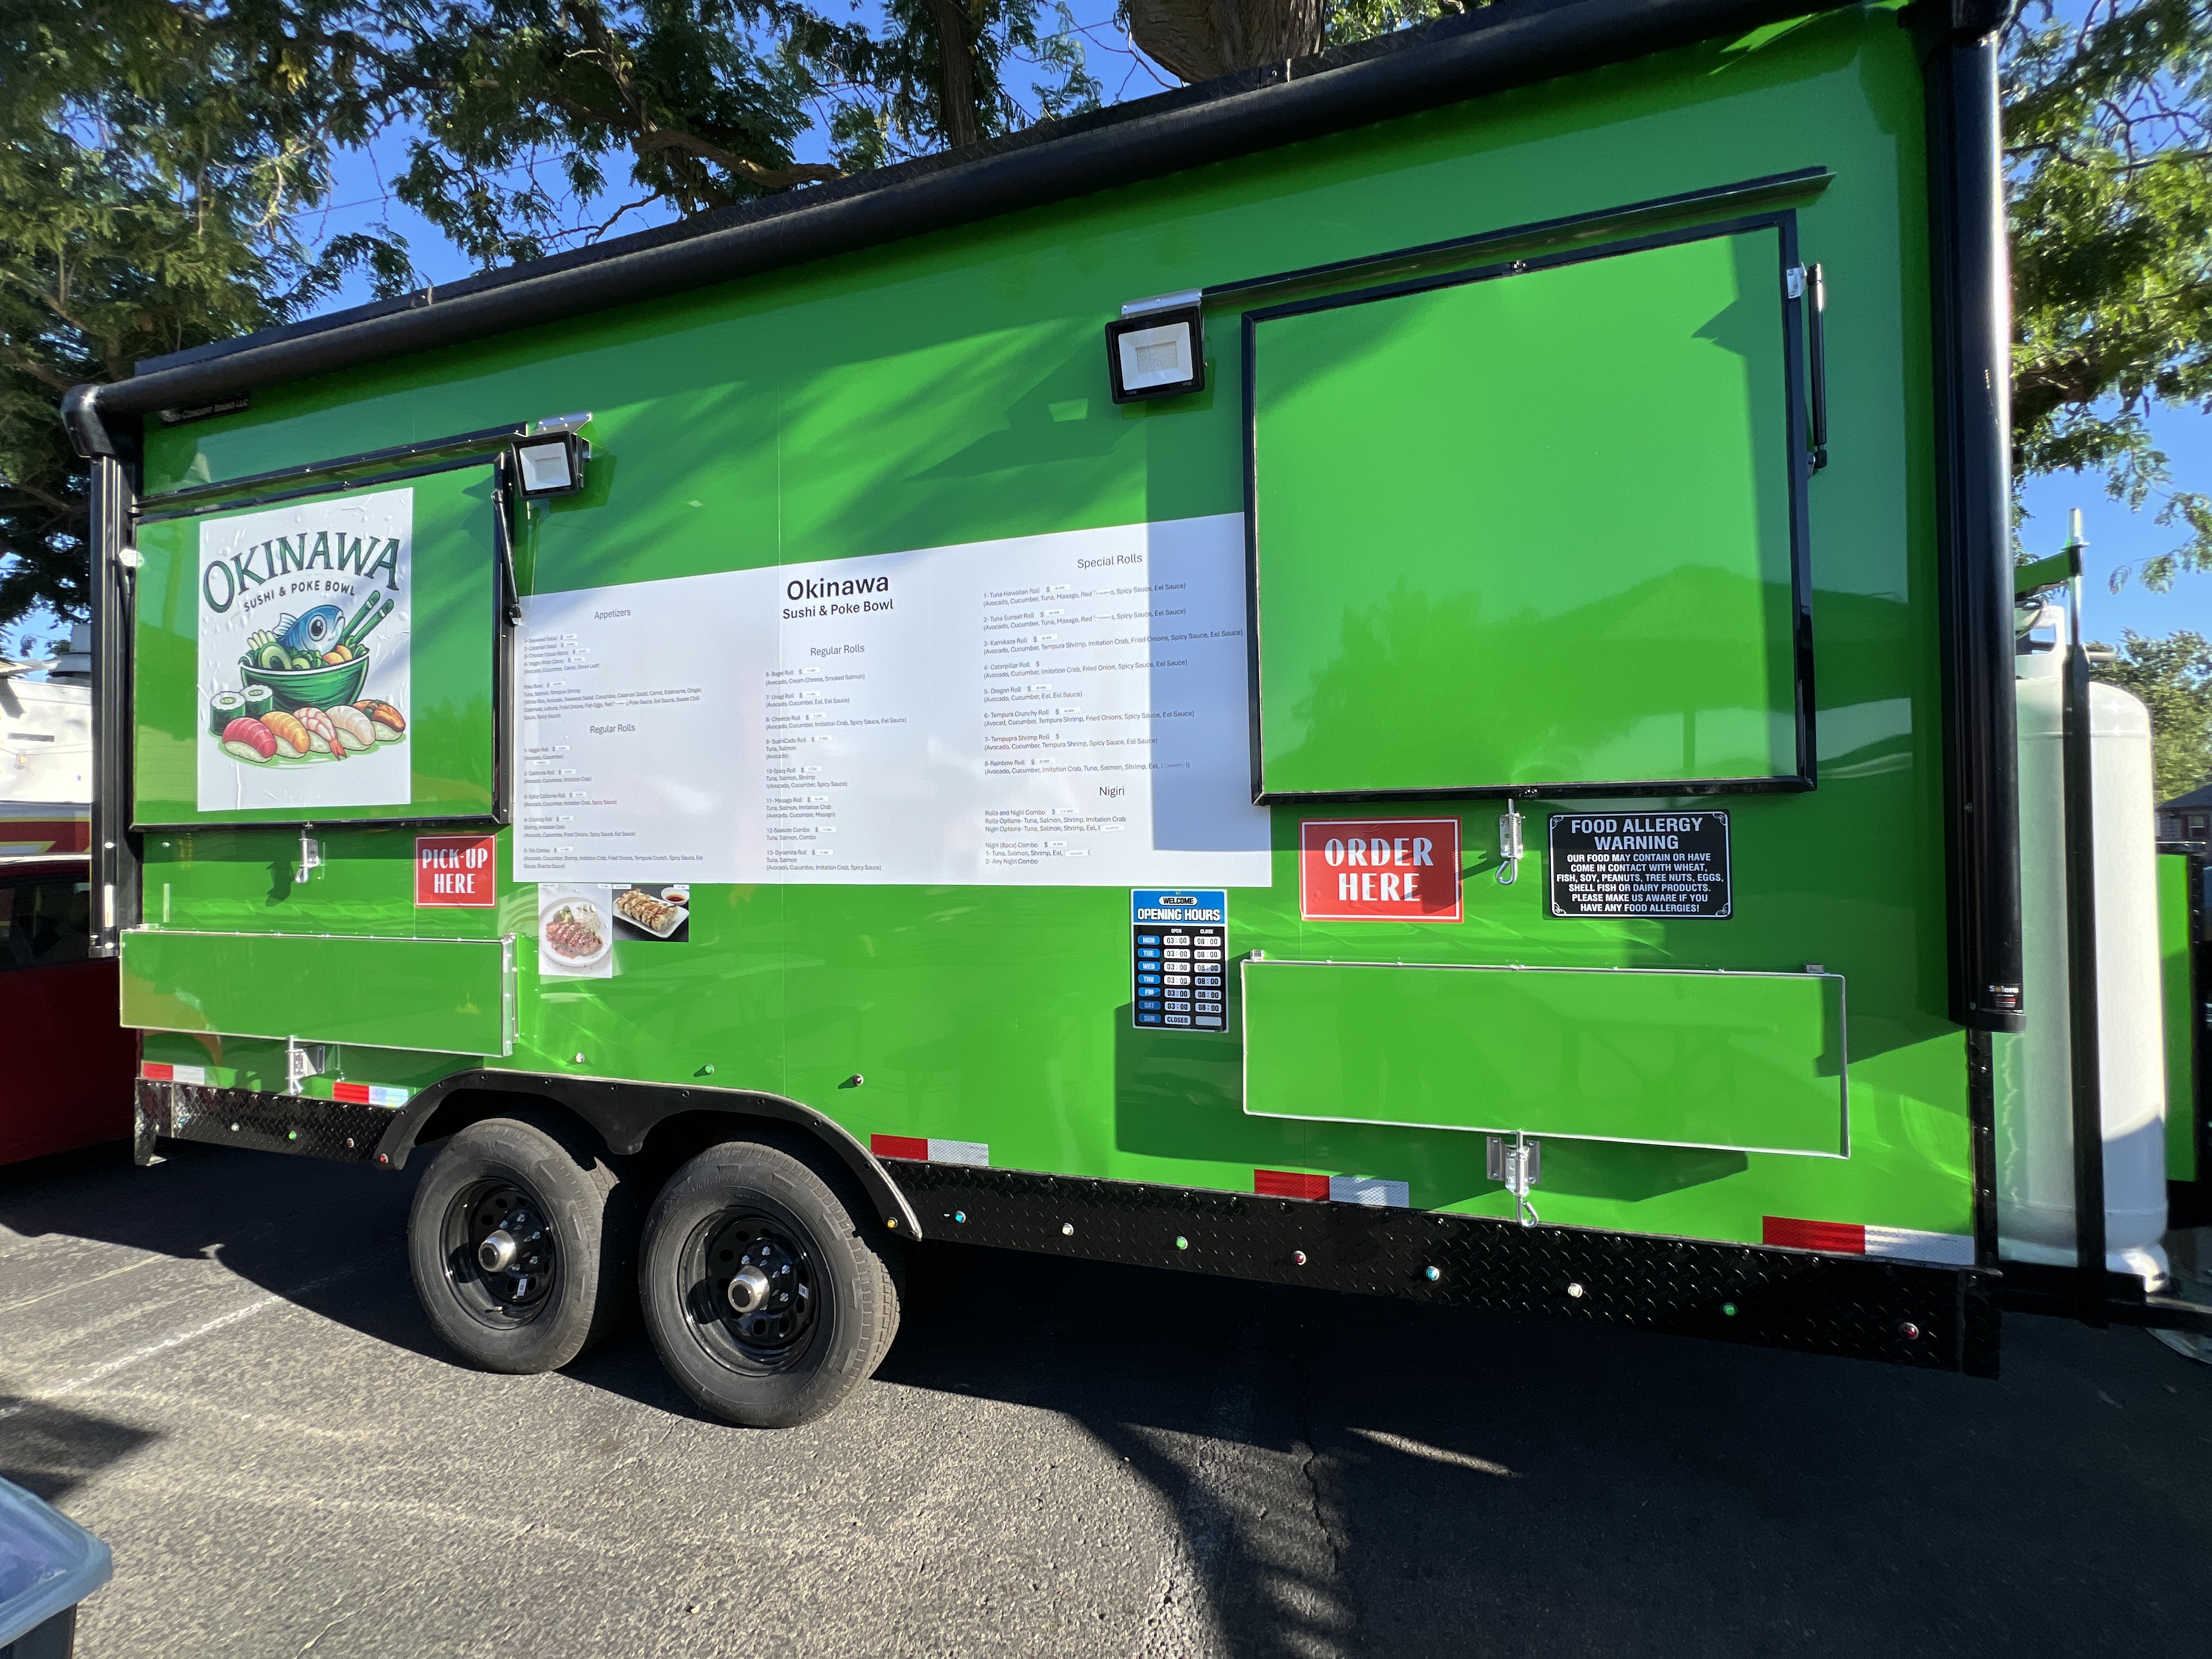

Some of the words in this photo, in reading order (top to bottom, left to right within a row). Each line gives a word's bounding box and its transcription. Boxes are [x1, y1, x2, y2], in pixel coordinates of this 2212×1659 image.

[1077, 556, 1114, 569] Special
[1116, 554, 1143, 565] Rolls
[204, 532, 400, 613] OKINAWA
[787, 575, 889, 601] Okinawa
[244, 590, 275, 612] SUSHI
[279, 586, 286, 596] &
[291, 580, 320, 592] POKE
[325, 580, 356, 596] BOWL
[594, 609, 631, 620] Appetizers
[783, 606, 816, 619] Sushi
[819, 606, 827, 616] &
[831, 602, 860, 615] Poke
[864, 599, 894, 612] Bowl
[810, 646, 842, 657] Regular
[844, 644, 865, 653] Rolls
[590, 725, 616, 735] Regular
[618, 724, 635, 732] Rolls
[1099, 786, 1125, 798] Nigiri
[1571, 819, 1617, 833] FOOD
[1622, 817, 1702, 832] ALLERGY
[1594, 834, 1678, 850] WARNING
[422, 848, 488, 869] PICK-UP
[1324, 837, 1434, 867] ORDER
[1567, 854, 1585, 862] OUR
[1587, 854, 1610, 862] FOOD
[1633, 853, 1670, 861] CONTAIN
[1688, 853, 1711, 861] HAVE
[1570, 864, 1595, 872] COME
[1596, 864, 1606, 872] IN
[1607, 864, 1646, 872] CONTACT
[1673, 863, 1707, 872] WHEAT,
[434, 873, 476, 894] HERE
[1556, 873, 1578, 883] FISH,
[1579, 873, 1599, 883] SOY,
[1601, 873, 1643, 882] PEANUTS,
[1669, 873, 1695, 882] NUTS,
[1697, 873, 1723, 882] EGGS,
[1338, 872, 1420, 902] HERE
[1568, 883, 1595, 891] SHELL
[1596, 883, 1616, 891] FISH
[1618, 883, 1630, 891] OR
[1633, 883, 1658, 891] DAIRY
[1661, 883, 1711, 891] PRODUCTS.
[1572, 893, 1603, 901] PLEASE
[1605, 893, 1629, 901] MAKE
[1137, 908, 1182, 921] OPENING
[1184, 909, 1221, 922] HOURS
[1580, 904, 1603, 912] HAVE
[1604, 904, 1622, 912] ANY
[1624, 904, 1647, 912] FOOD
[1649, 904, 1700, 912] ALLERGIES!
[1989, 985, 2019, 994] Solera
